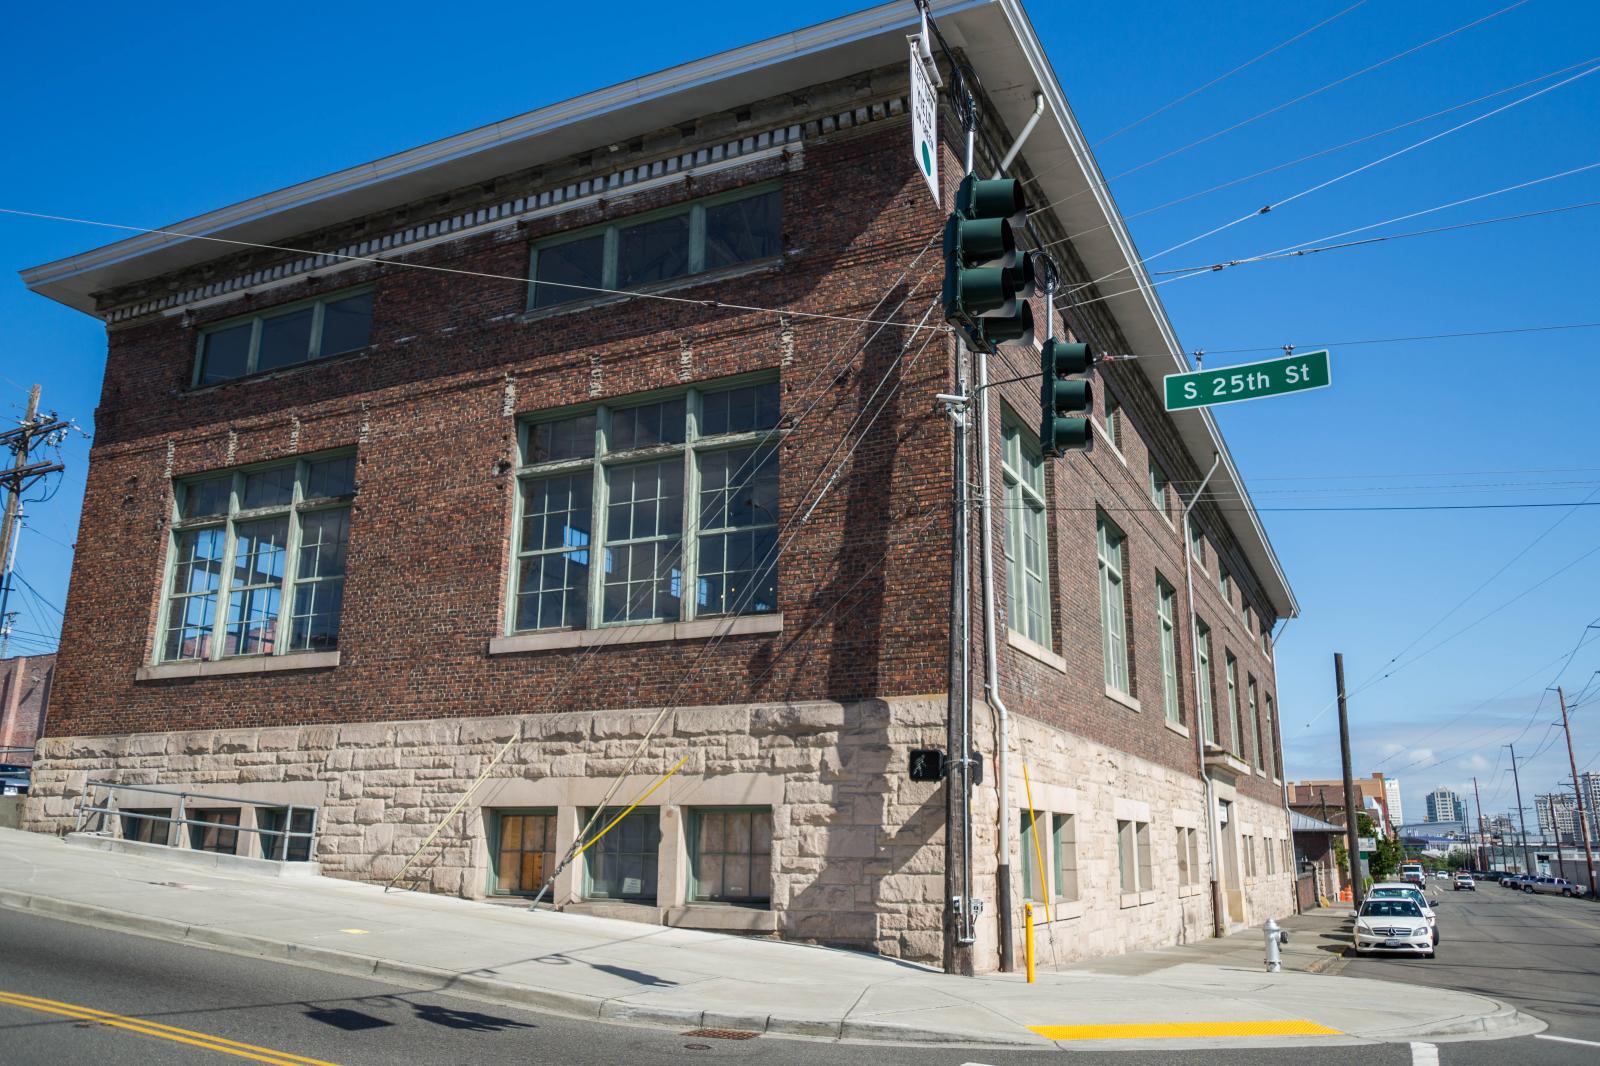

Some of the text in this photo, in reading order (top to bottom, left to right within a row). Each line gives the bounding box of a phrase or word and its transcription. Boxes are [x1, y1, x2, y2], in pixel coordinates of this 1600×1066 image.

[1184, 363, 1310, 400] S 25th St
